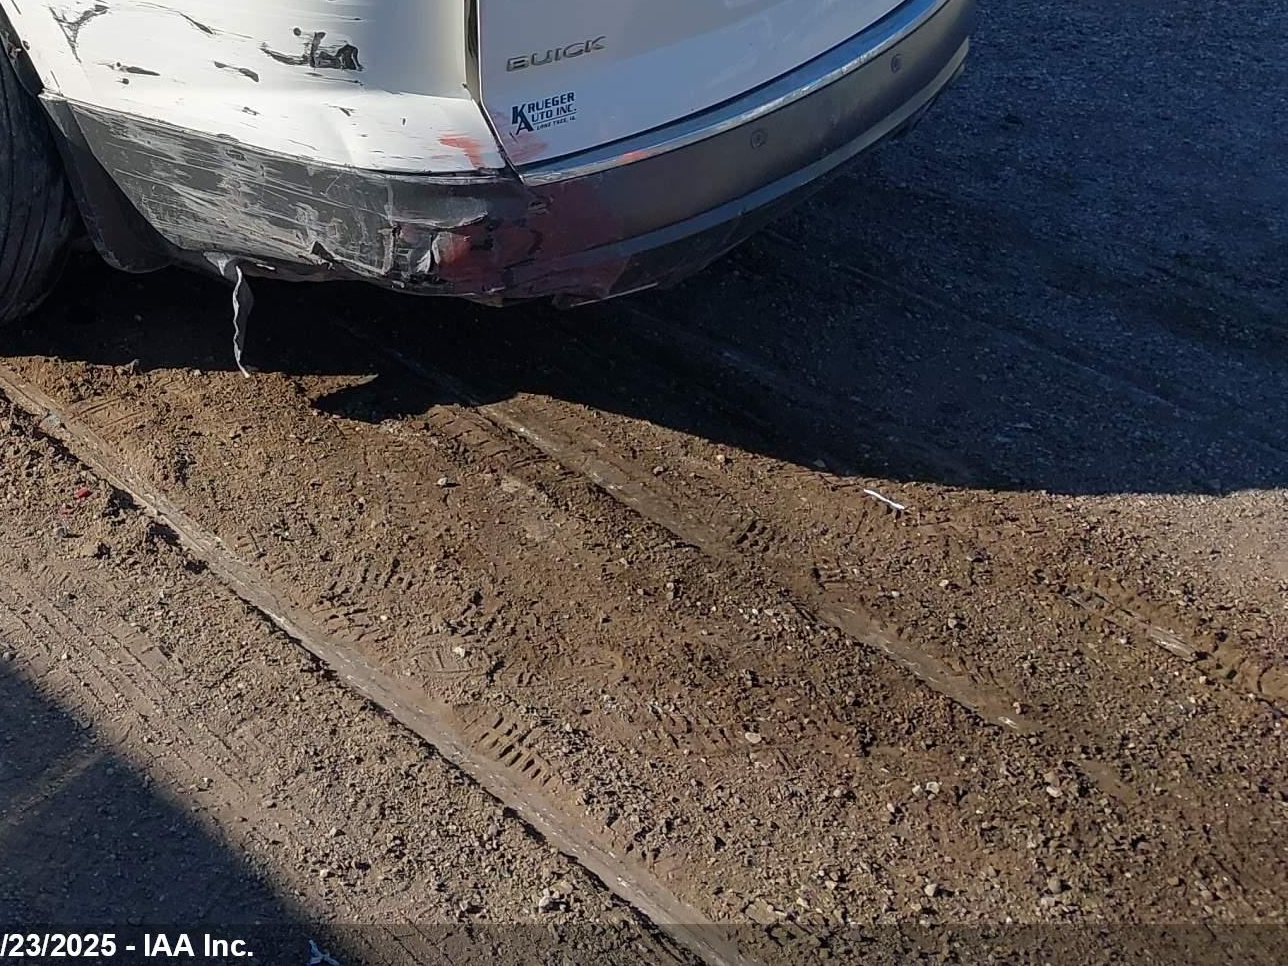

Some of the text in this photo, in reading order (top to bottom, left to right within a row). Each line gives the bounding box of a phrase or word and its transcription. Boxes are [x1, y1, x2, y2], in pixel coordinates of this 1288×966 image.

[506, 35, 607, 72] BUICK
[511, 91, 575, 125] KRUEGER
[556, 103, 577, 116] INC.
